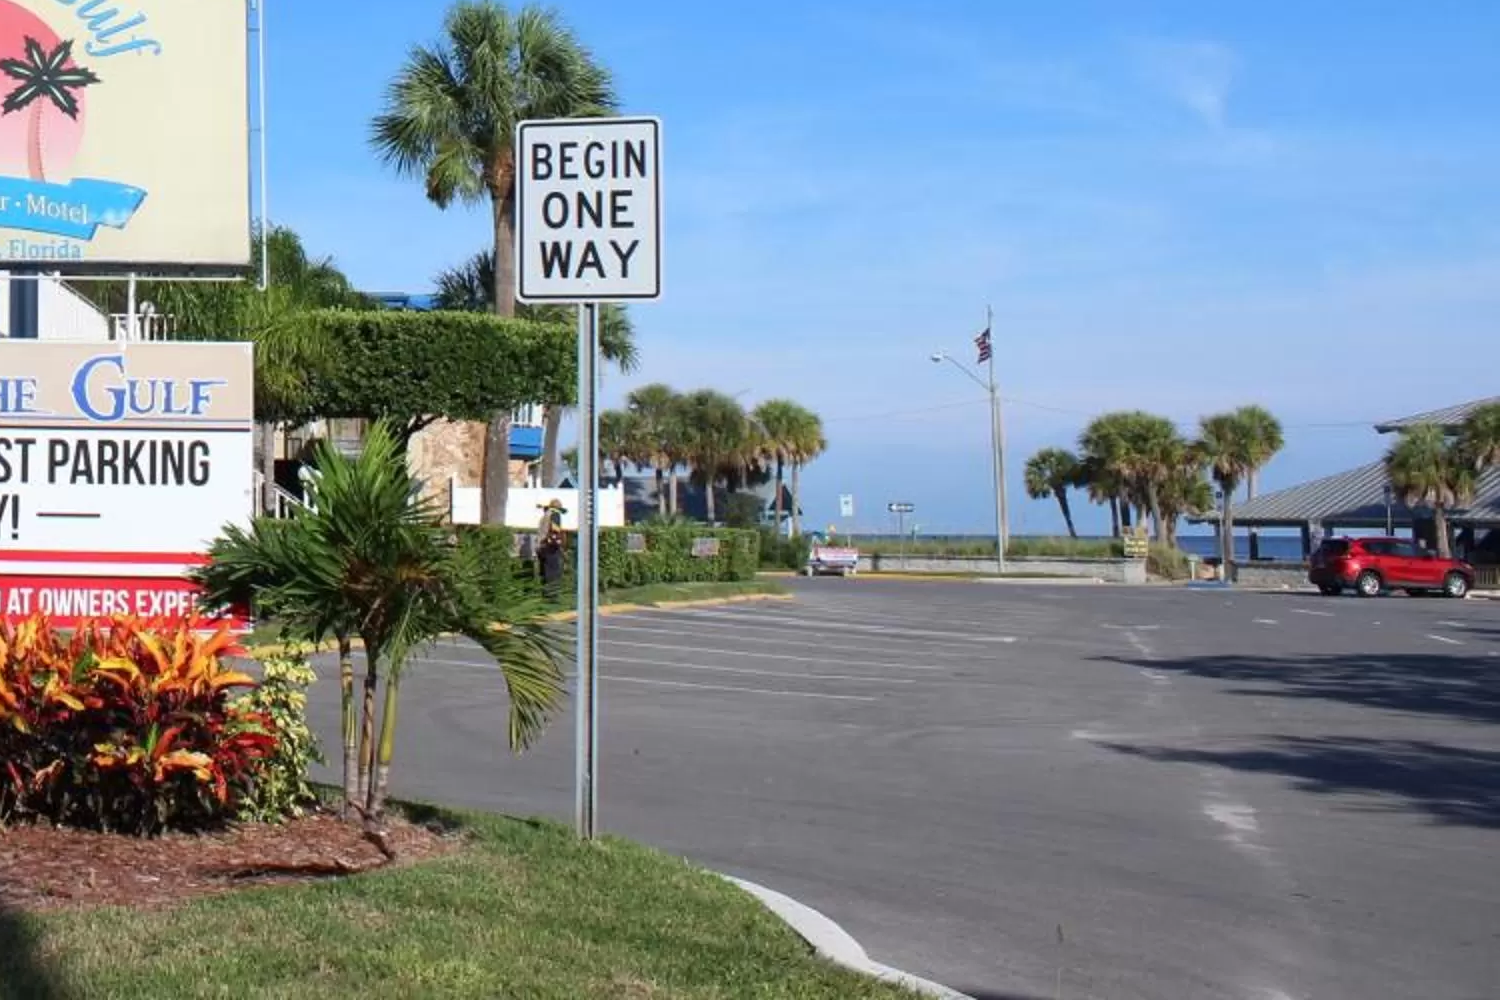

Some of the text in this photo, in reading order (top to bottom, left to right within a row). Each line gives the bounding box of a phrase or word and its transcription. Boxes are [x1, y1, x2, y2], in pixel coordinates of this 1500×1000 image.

[532, 140, 646, 181] BEGIN
[26, 192, 88, 225] Motel
[542, 190, 635, 229] ONE
[9, 239, 84, 259] Florida
[540, 240, 639, 279] WAY
[48, 439, 210, 486] PARKING
[7, 588, 33, 615] AT
[39, 588, 129, 616] OWNERS
